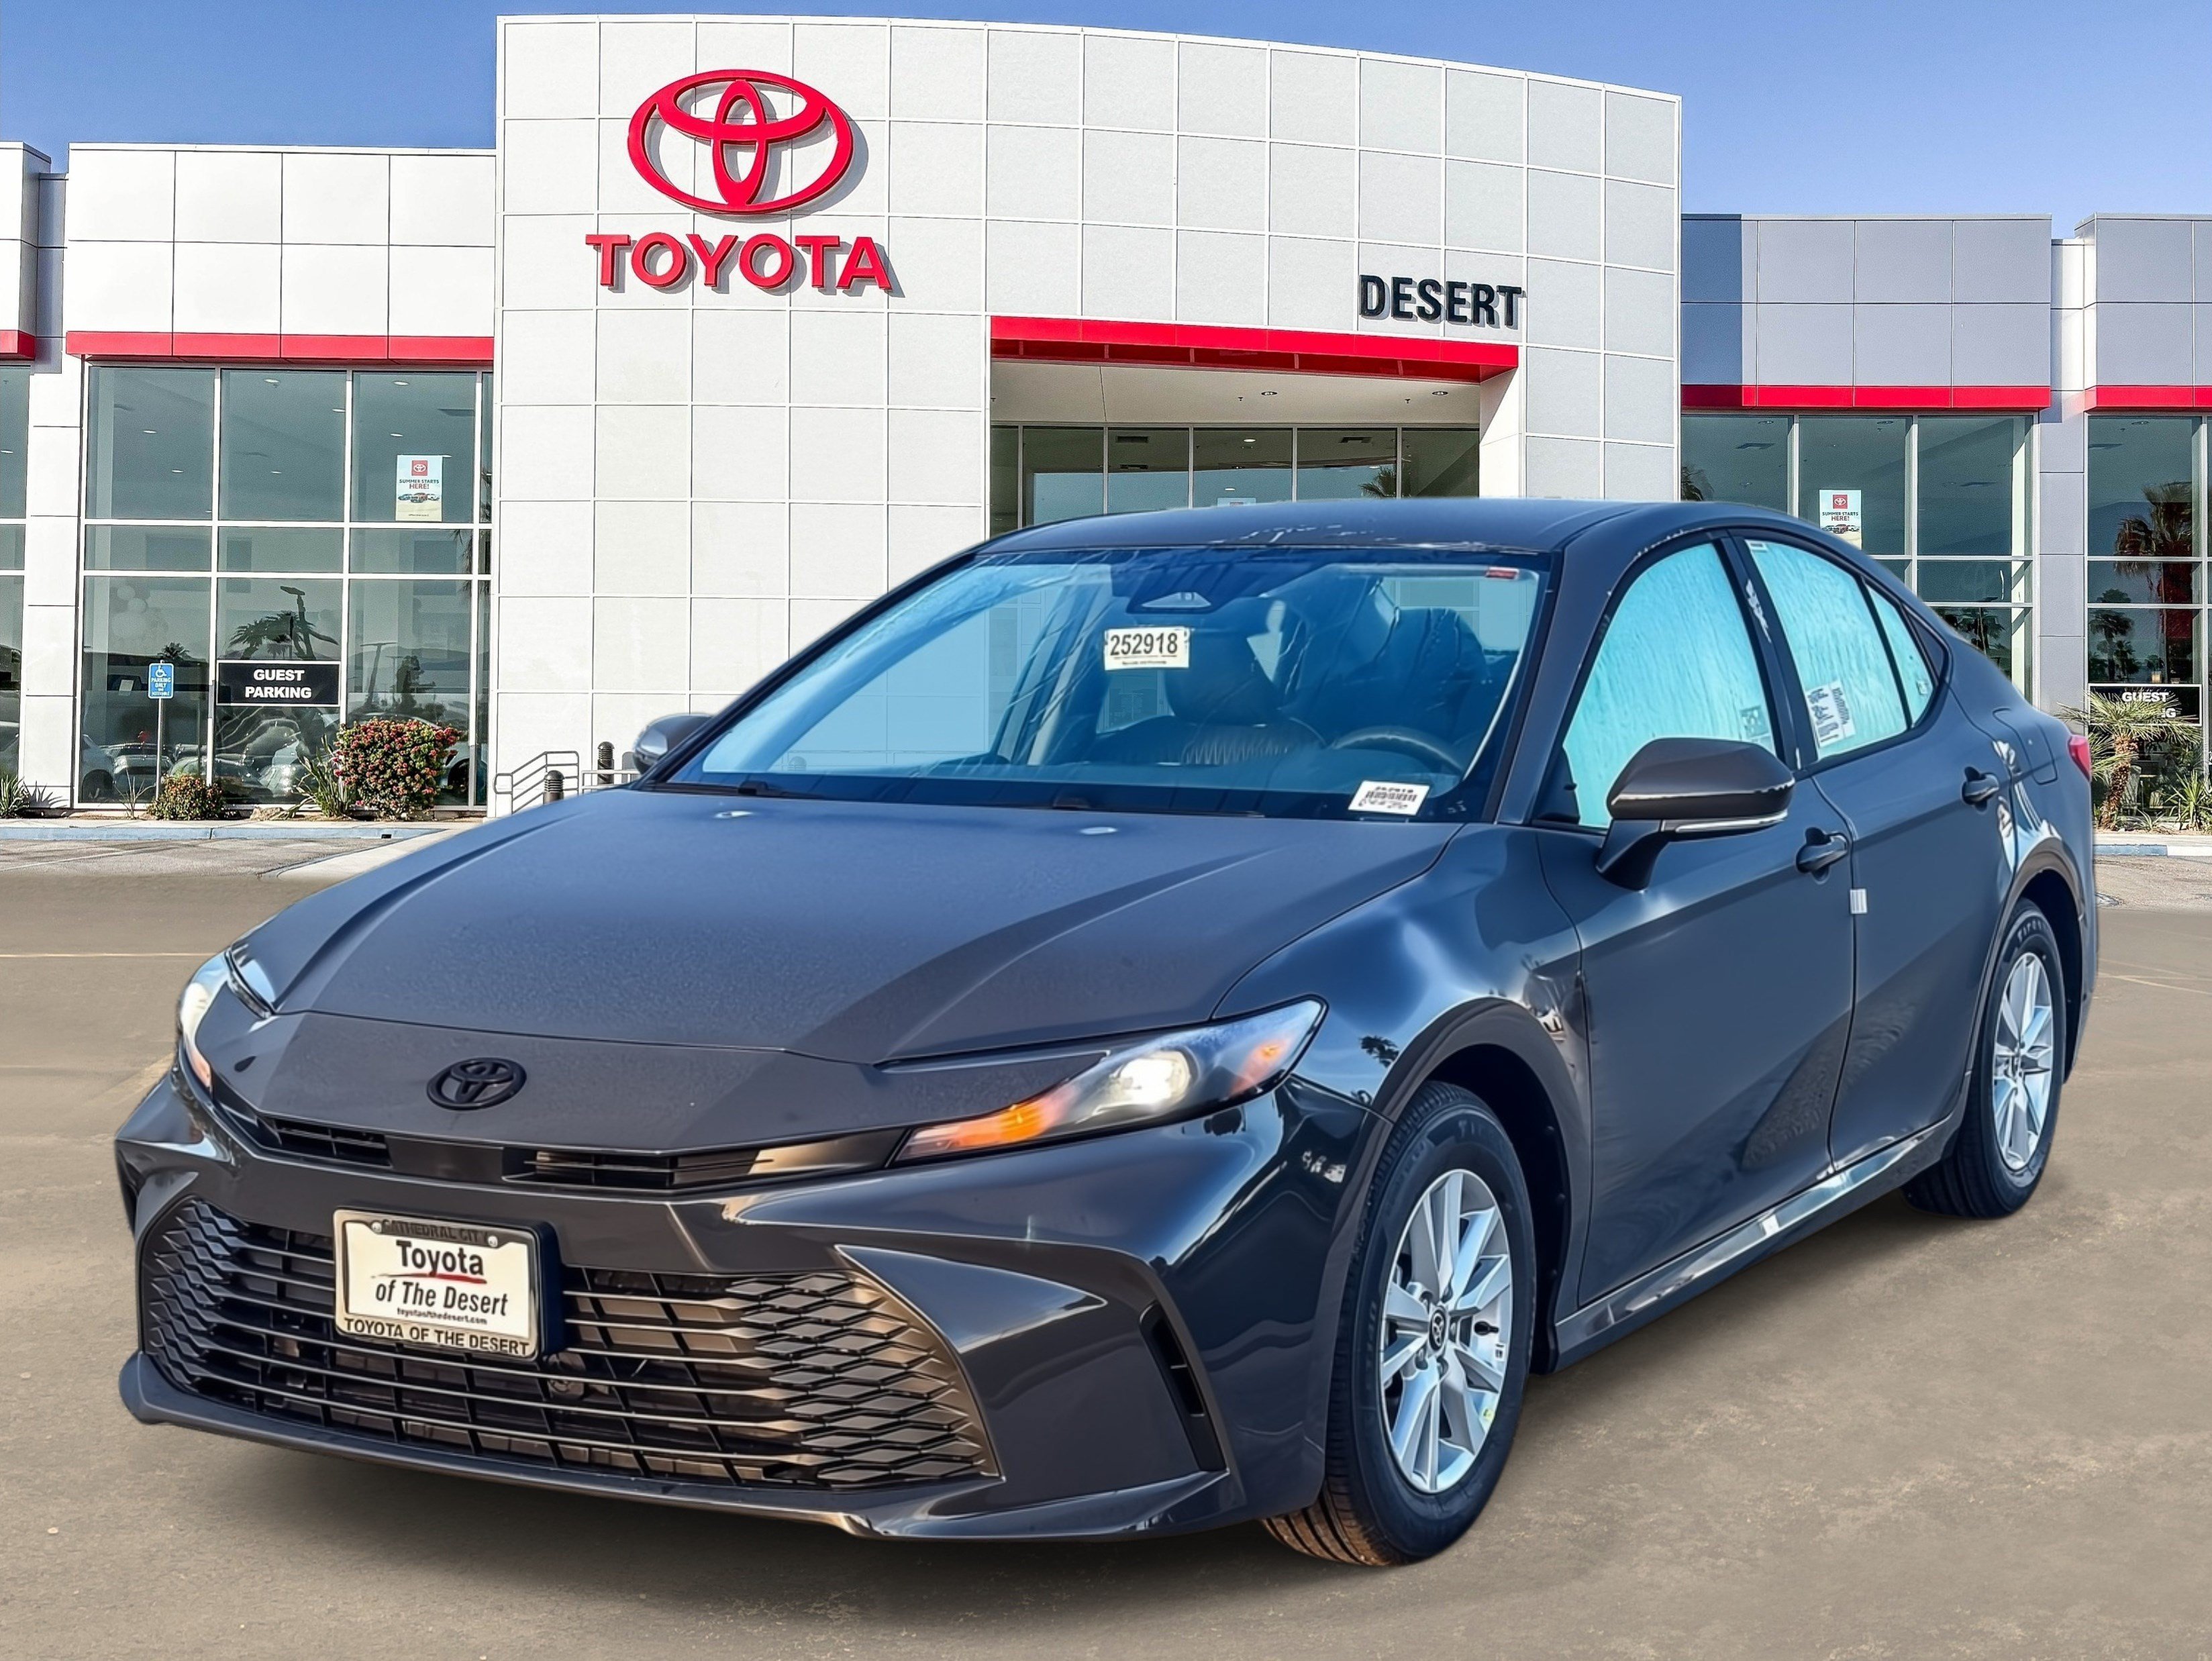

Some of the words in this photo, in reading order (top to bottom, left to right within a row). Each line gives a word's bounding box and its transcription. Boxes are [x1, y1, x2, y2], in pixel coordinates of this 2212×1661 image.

[585, 232, 893, 290] TOYOTA
[1359, 274, 1521, 326] DESERT
[1110, 632, 1178, 656] 252918
[245, 686, 312, 699] PARKING
[253, 668, 305, 681] GUEST
[2121, 691, 2169, 703] GUEST
[397, 1240, 484, 1276] Toyota
[375, 1279, 397, 1302] of
[403, 1281, 436, 1307] The
[444, 1286, 508, 1316] Desert
[344, 1317, 403, 1338] TOYOTA
[409, 1327, 430, 1341] OF
[434, 1329, 465, 1346] THE
[469, 1335, 530, 1356] DESERT
